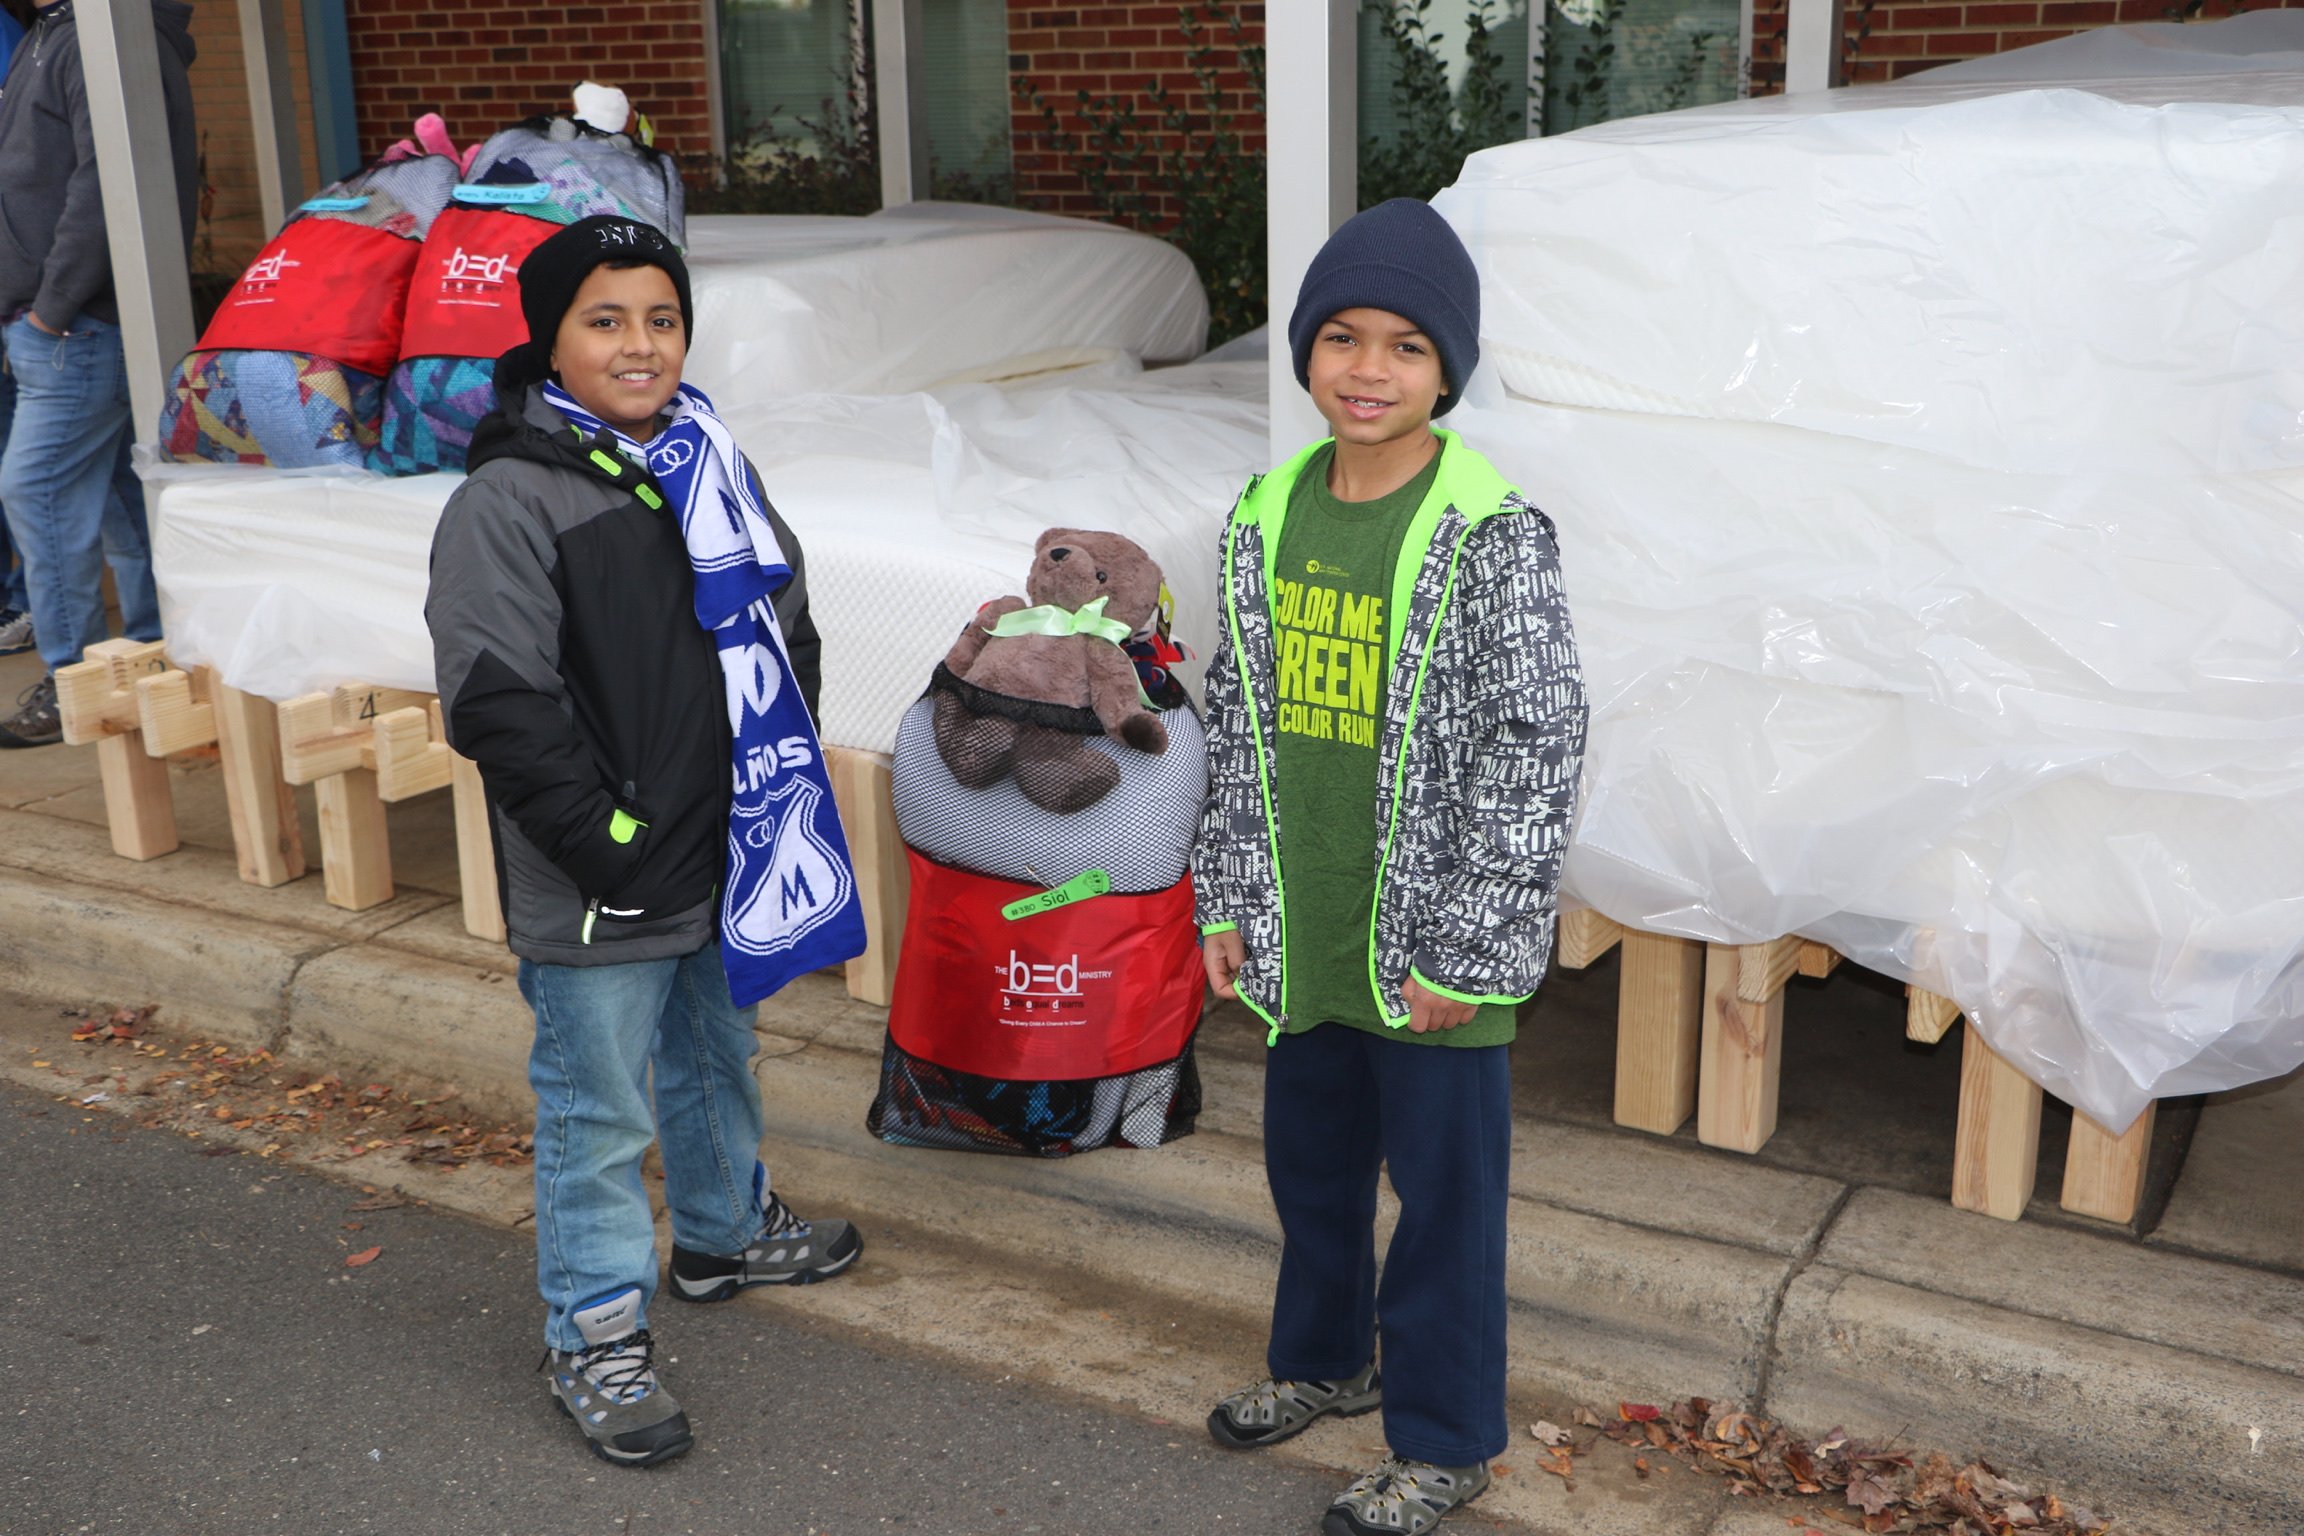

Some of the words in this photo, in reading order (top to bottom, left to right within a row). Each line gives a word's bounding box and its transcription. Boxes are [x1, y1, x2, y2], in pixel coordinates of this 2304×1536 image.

[1340, 592, 1383, 644] ME
[359, 691, 379, 724] 4
[1279, 703, 1334, 740] COLOR
[1339, 712, 1375, 749] RUN
[780, 862, 817, 922] M
[1041, 891, 1070, 908] Siol
[994, 965, 1009, 975] THE
[1078, 970, 1113, 980] MINISTRY
